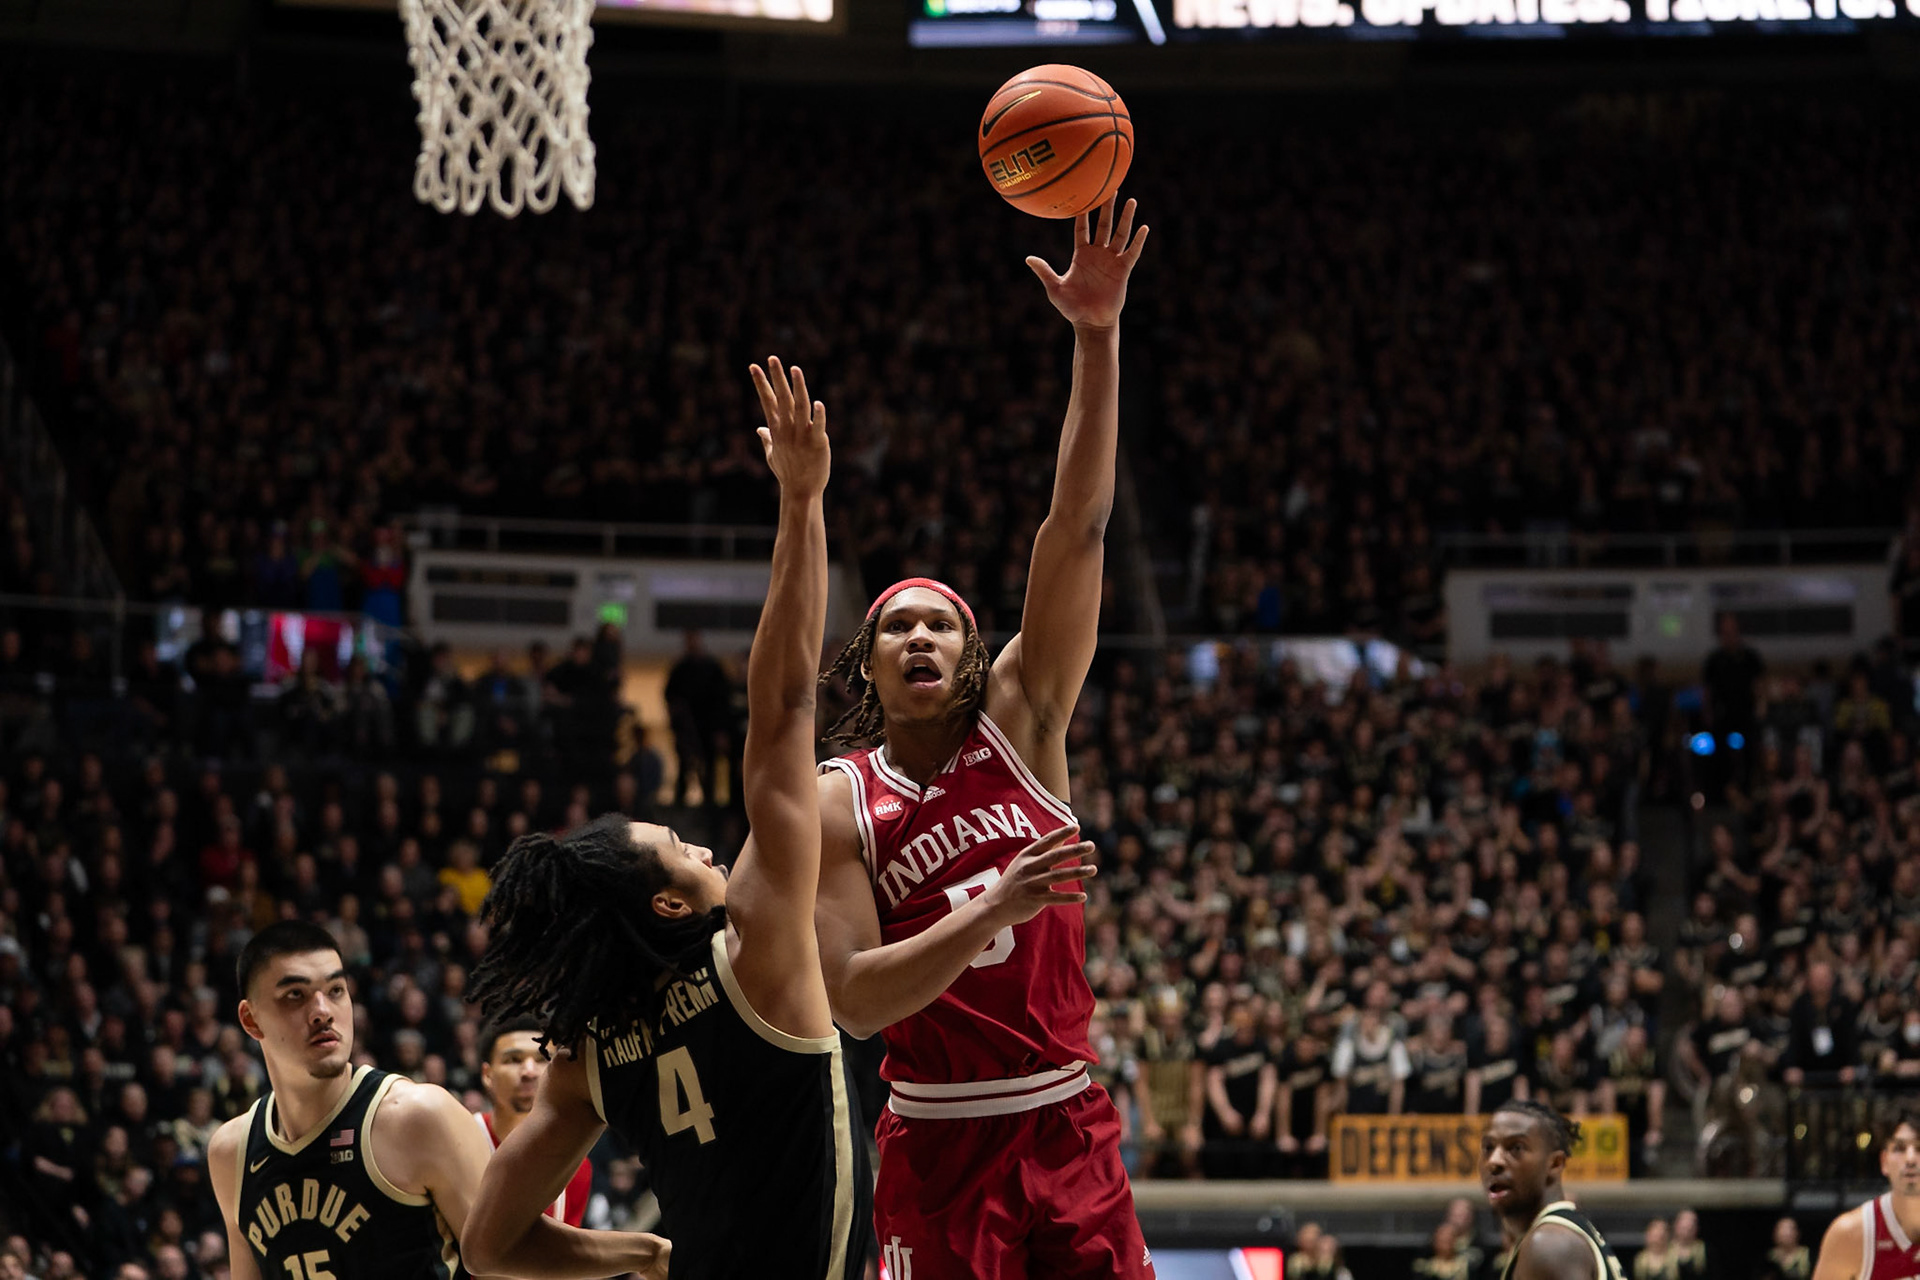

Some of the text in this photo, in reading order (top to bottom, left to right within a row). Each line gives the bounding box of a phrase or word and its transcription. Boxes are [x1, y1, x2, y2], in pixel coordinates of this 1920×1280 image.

[990, 139, 1055, 181] ELITE
[874, 800, 903, 817] RMK
[878, 803, 1041, 909] INDIANA
[657, 1045, 716, 1145] 4
[1340, 1125, 1476, 1176] DEFENS
[249, 1178, 371, 1257] PURDUE
[283, 1249, 338, 1280] 15
